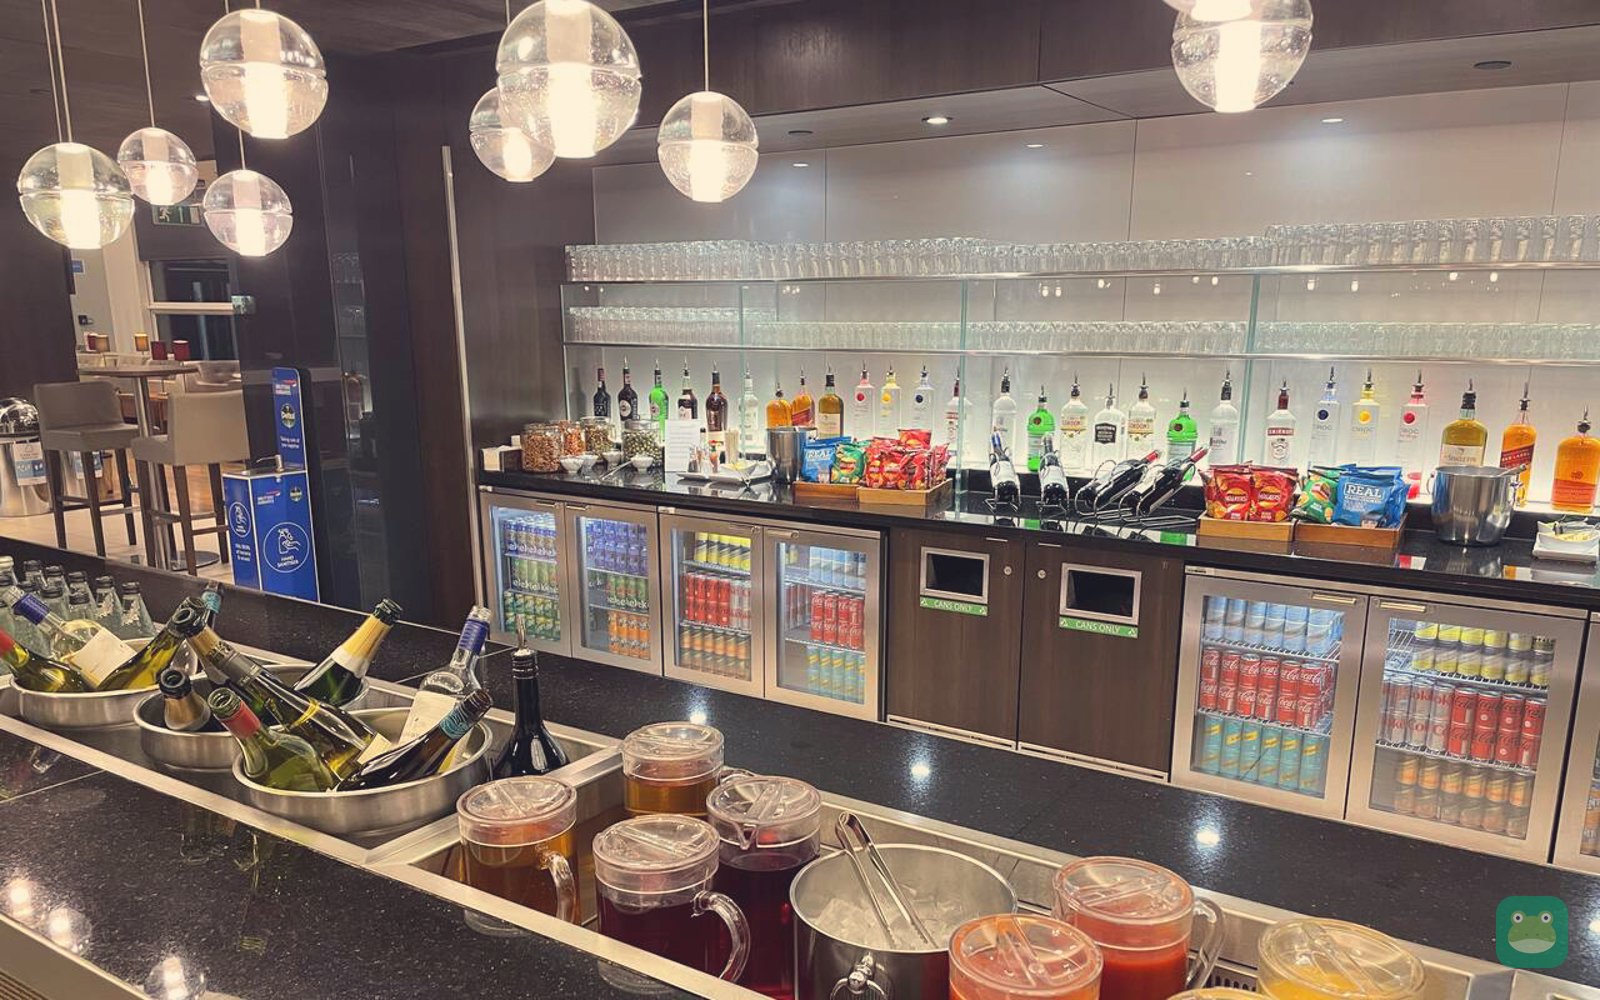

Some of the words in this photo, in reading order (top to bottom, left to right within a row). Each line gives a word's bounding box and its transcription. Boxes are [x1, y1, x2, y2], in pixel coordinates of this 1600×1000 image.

[1346, 483, 1382, 498] REAL
[933, 600, 951, 608] CANS
[953, 602, 973, 611] ONLY
[1075, 620, 1097, 631] CANS
[1099, 623, 1121, 633] ONLY
